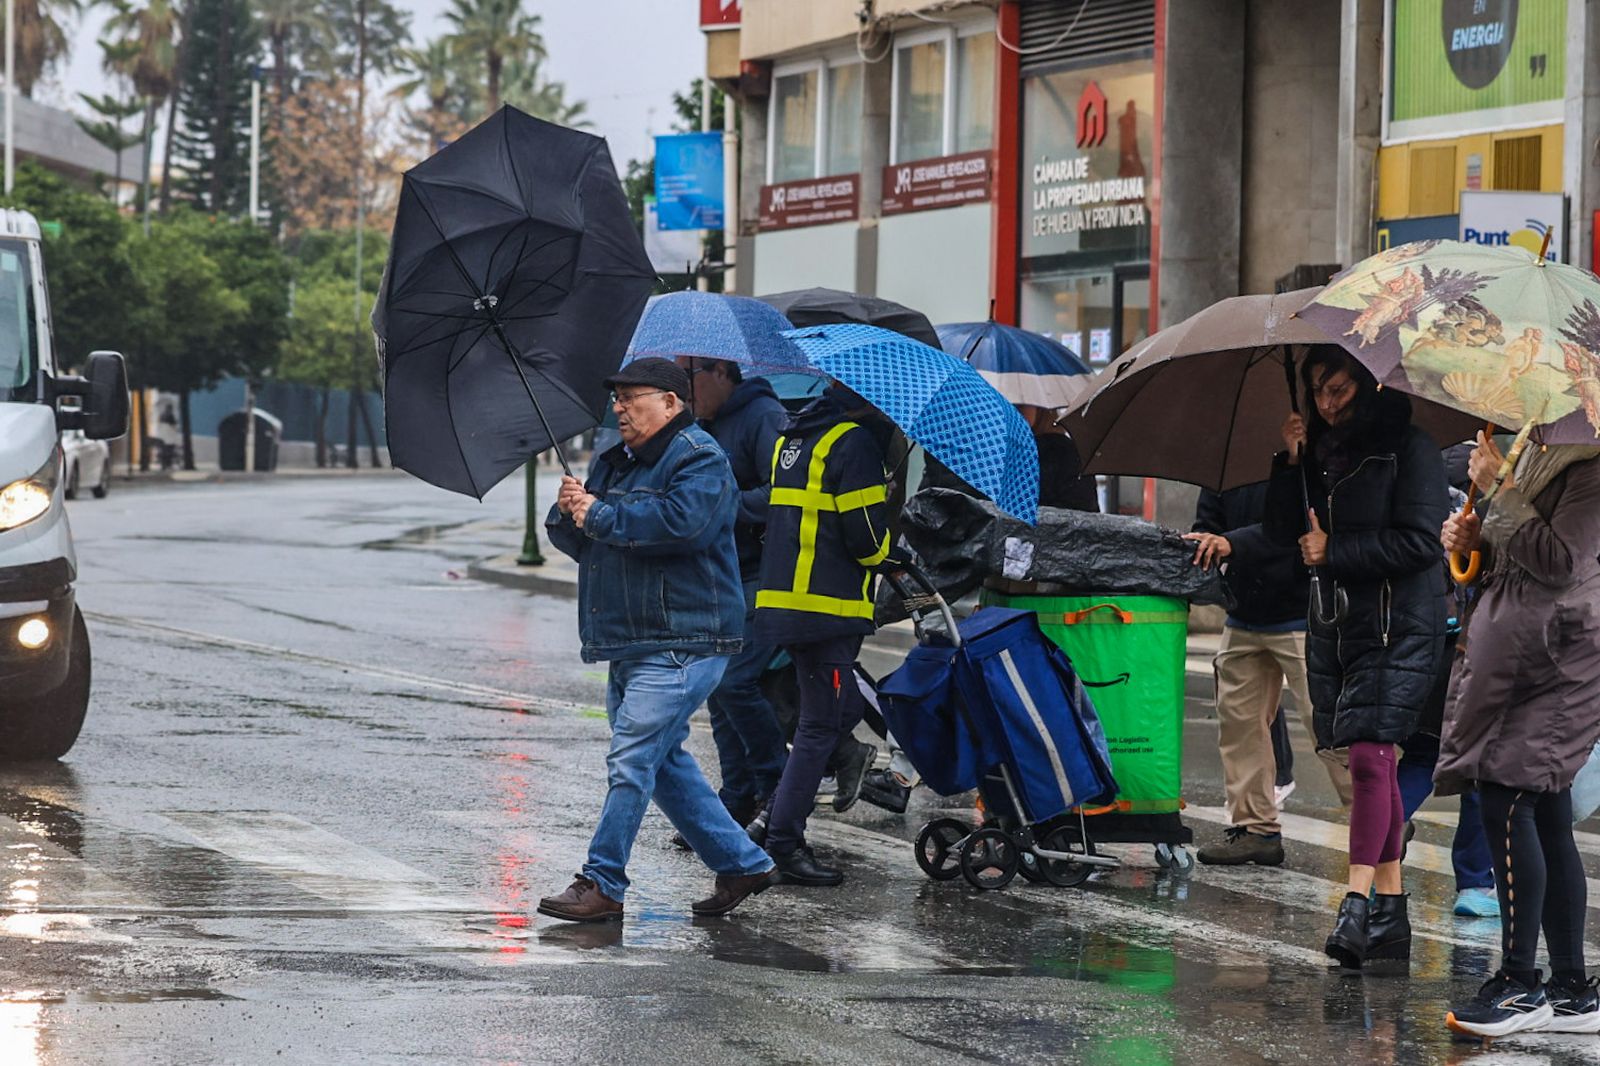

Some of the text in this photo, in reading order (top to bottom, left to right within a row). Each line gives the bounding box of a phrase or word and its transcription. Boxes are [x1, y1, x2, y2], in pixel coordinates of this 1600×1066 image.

[1033, 155, 1089, 185] CÁMARA DE
[1033, 176, 1145, 211] LA PROPIEDAD URBANA
[1033, 214, 1047, 237] DE
